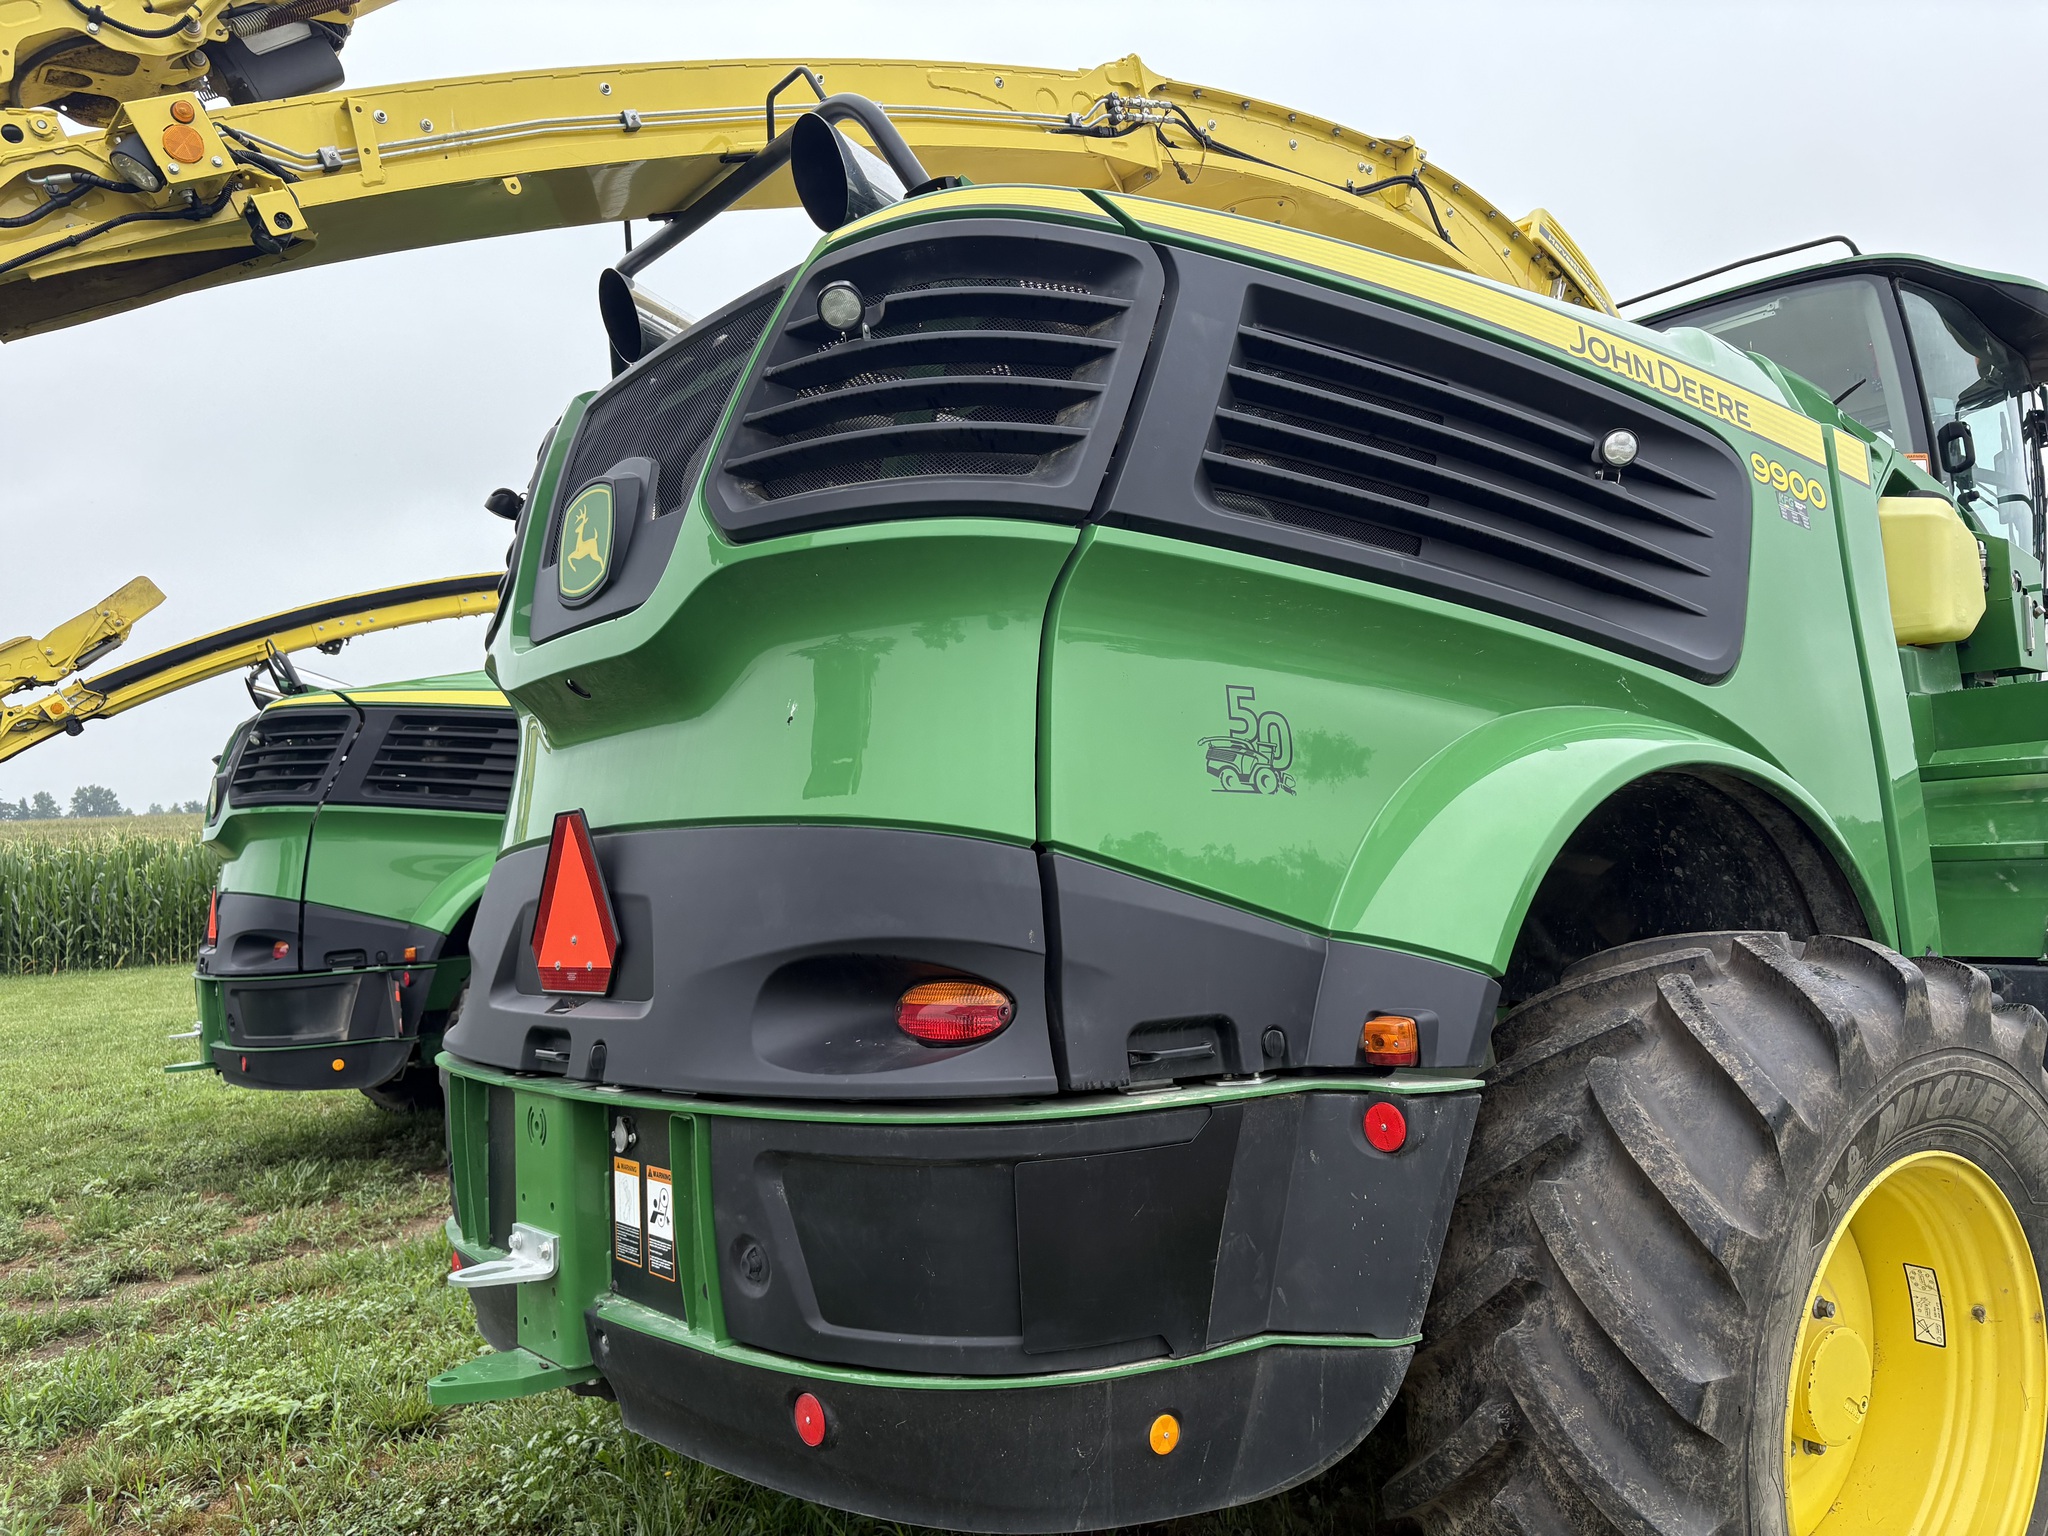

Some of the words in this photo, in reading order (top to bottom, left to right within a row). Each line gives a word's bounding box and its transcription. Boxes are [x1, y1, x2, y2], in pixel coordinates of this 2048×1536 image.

[1548, 234, 1590, 285] HarvestLab
[1589, 285, 1608, 308] 3000
[1570, 326, 1655, 385] JOHN
[1657, 359, 1752, 428] DEERE
[1750, 451, 1828, 510] 9900
[1226, 684, 1293, 772] 50
[620, 1162, 638, 1173] WARNING
[652, 1170, 672, 1182] WARNING
